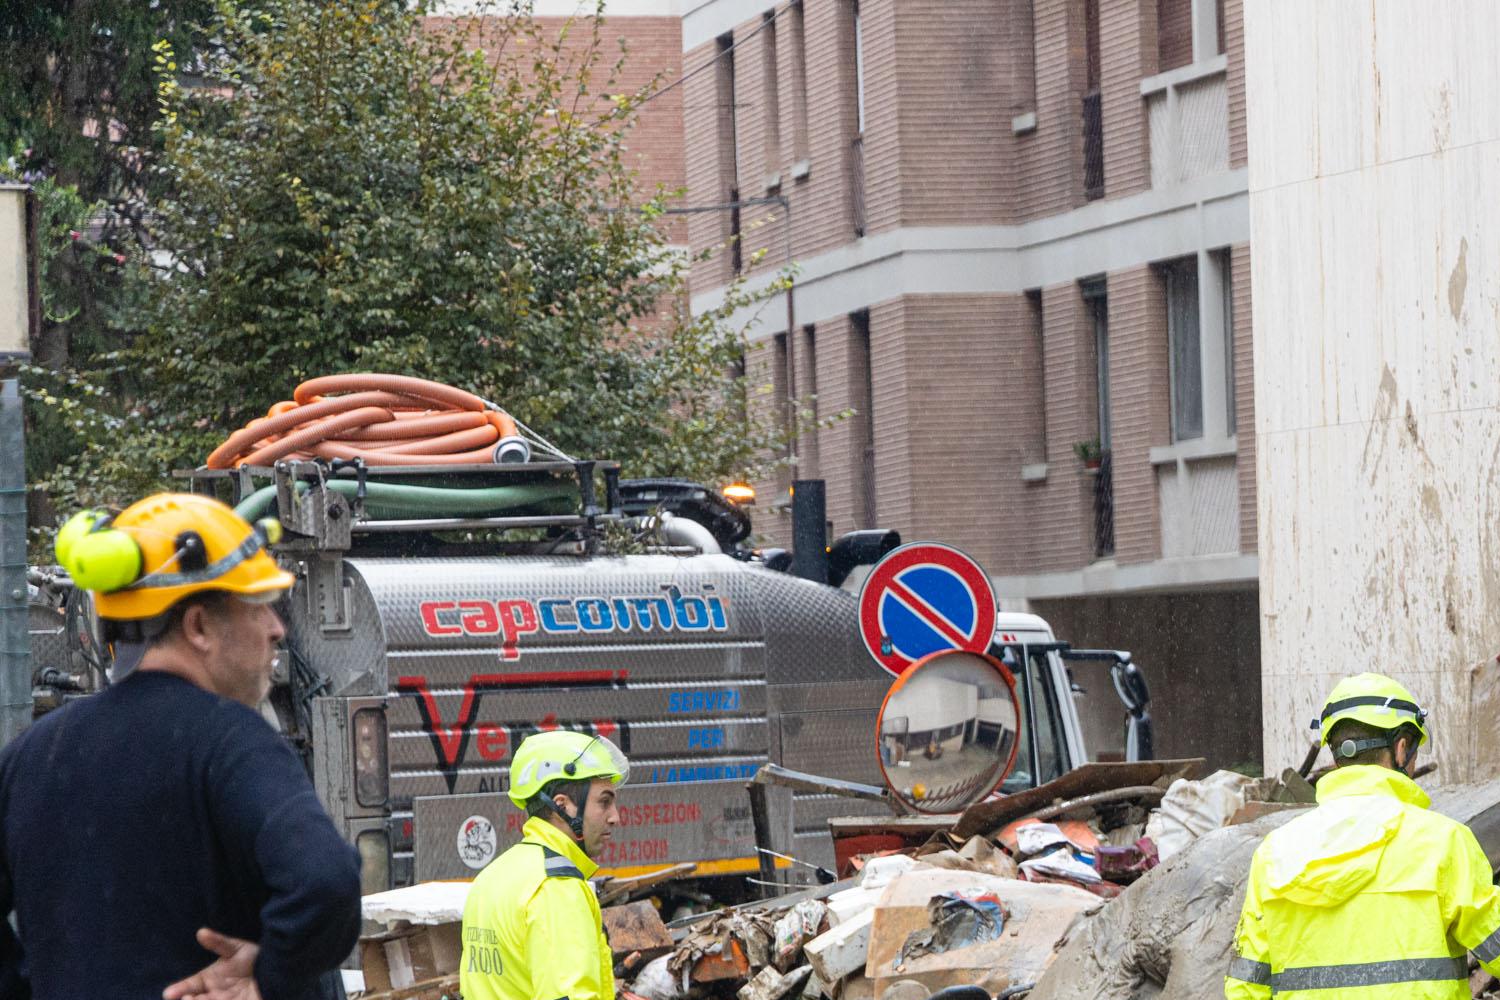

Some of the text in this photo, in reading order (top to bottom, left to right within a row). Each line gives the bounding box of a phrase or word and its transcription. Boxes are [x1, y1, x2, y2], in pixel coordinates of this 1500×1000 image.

[420, 583, 729, 662] capcombi
[668, 688, 739, 712] SERVIZI
[687, 728, 724, 749] PER
